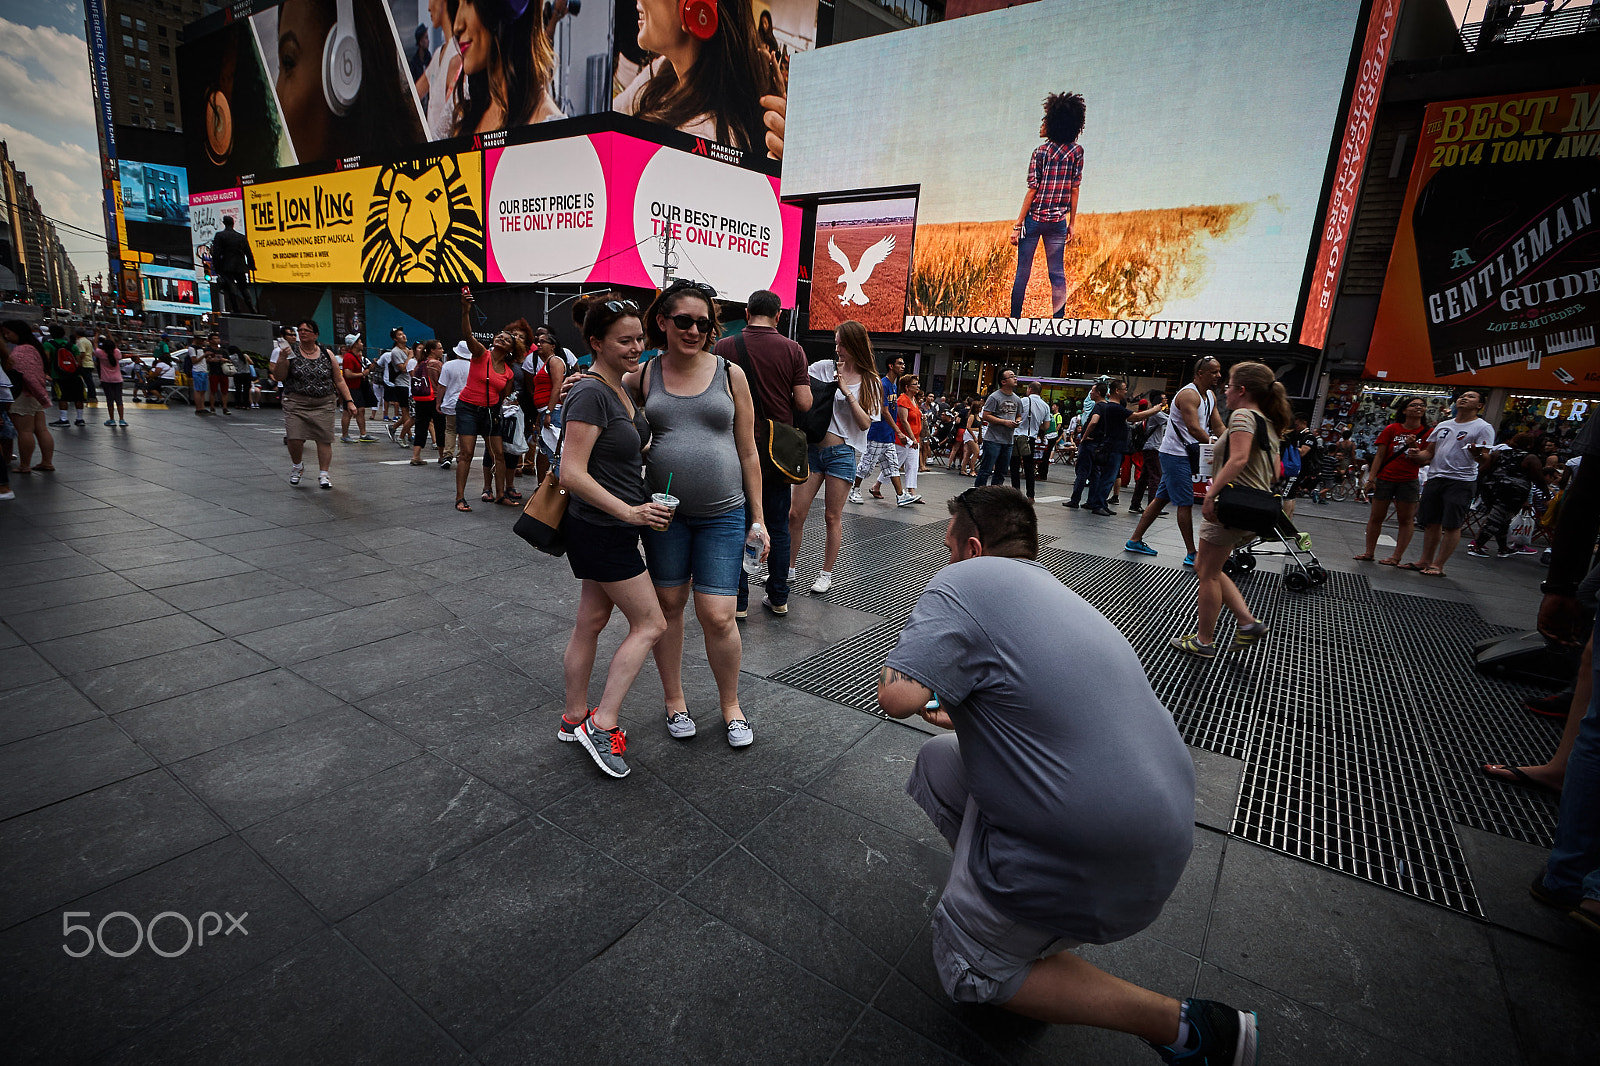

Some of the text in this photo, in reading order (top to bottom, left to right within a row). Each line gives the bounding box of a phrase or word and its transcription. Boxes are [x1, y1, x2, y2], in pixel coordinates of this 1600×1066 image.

[98, 51, 106, 63] TO
[100, 64, 111, 99] ATTEND
[1426, 121, 1443, 135] THE
[1434, 96, 1559, 144] BEST
[483, 130, 508, 140] MARRIOTT
[483, 138, 505, 147] MARQUIS
[710, 150, 740, 164] MARQUIS
[711, 142, 744, 158] MARRIOTT
[1326, 59, 1371, 241] OUTFITTERS
[1430, 142, 1485, 168] 2014
[1491, 137, 1553, 164] TONY
[193, 196, 201, 204] NOW
[202, 193, 218, 202] THROUGH
[219, 191, 234, 200] AUGUST
[250, 201, 275, 226] THE
[276, 191, 311, 232] LION
[313, 185, 354, 230] KING
[499, 192, 595, 215] OUR BEST PRICE IS
[499, 210, 594, 233] THE ONLY PRICE
[650, 201, 771, 241] OUR BEST PRICE IS
[255, 233, 355, 248] THE AWARD-WINNING BEST MUSICAL
[650, 217, 769, 258] THE ONLY PRICE
[1319, 205, 1350, 309] EAGLE
[1449, 247, 1476, 270] A
[1499, 267, 1600, 312] GUIDE
[1528, 303, 1586, 329] MURDER
[907, 316, 1289, 344] AMERICAN EAGLE OUTFITTERS
